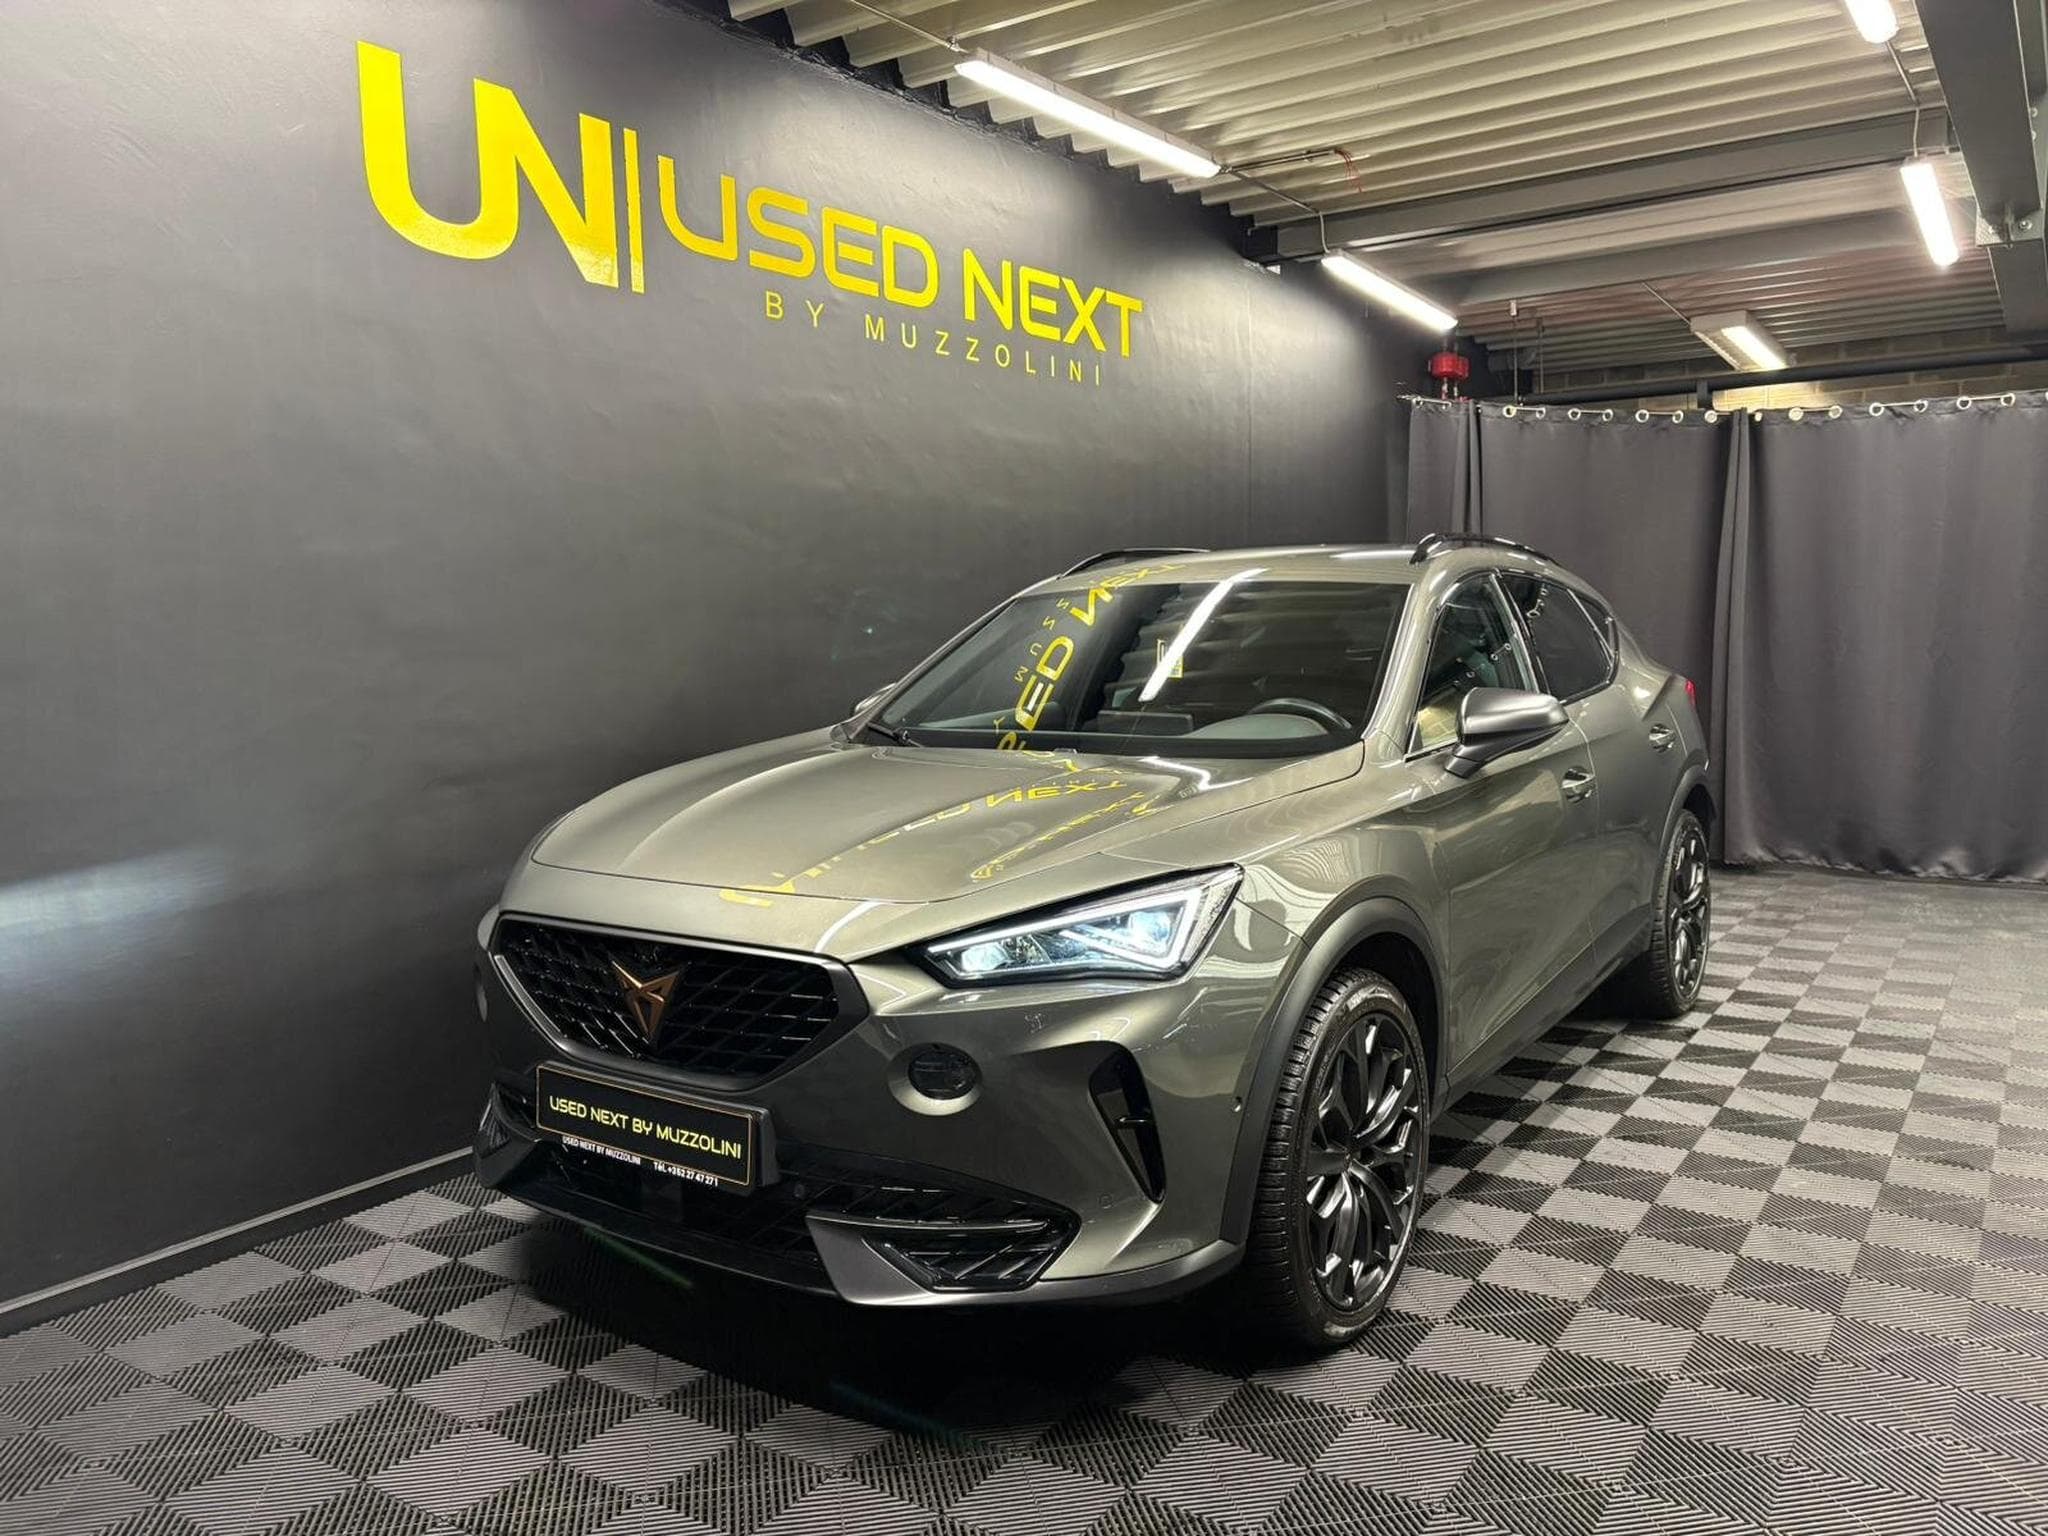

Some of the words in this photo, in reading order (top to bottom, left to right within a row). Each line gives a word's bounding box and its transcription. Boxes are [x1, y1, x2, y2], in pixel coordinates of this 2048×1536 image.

[658, 155, 939, 308] USED
[963, 248, 1143, 358] NEXT
[765, 291, 825, 328] BY
[865, 313, 1102, 386] MUZZOLINI
[550, 1095, 587, 1119] USED
[590, 1106, 629, 1129] NEXT
[632, 1118, 653, 1136] BY
[656, 1124, 742, 1160] MUZZOLINI
[562, 1135, 580, 1148] USED
[579, 1139, 596, 1153] NEXT
[596, 1143, 605, 1155] BY
[605, 1147, 641, 1166] MUZZOLINI
